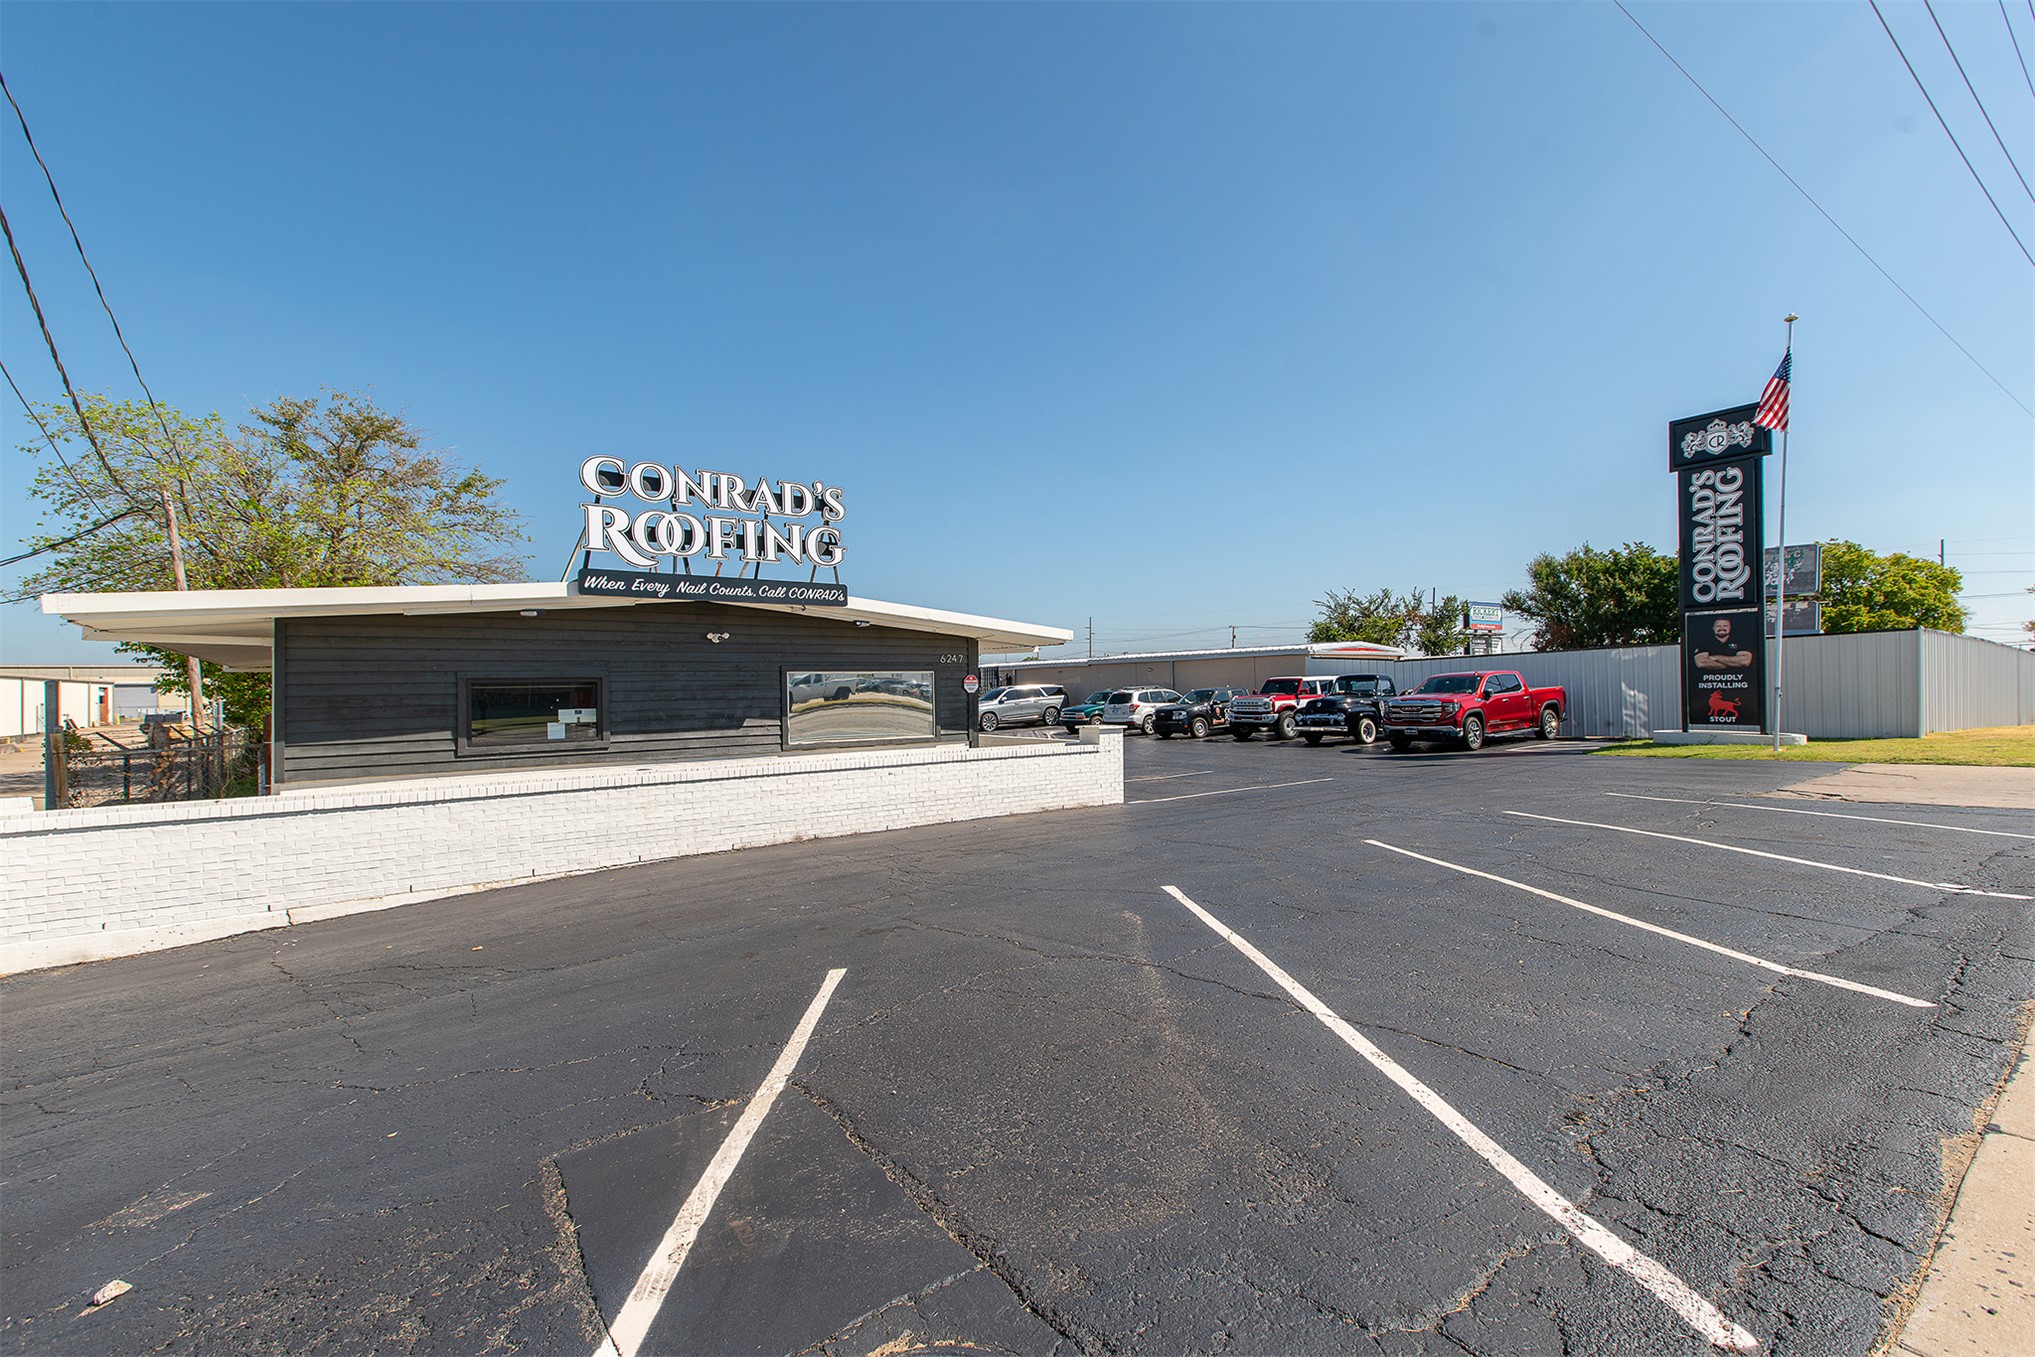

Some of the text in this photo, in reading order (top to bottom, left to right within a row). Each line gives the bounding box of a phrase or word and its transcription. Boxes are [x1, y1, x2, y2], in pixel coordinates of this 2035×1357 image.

[579, 454, 846, 523] CONRAD'S
[579, 502, 848, 568] ROOFING
[1688, 469, 1717, 603] CONRAD'S
[1715, 466, 1751, 602] ROOFING
[583, 575, 626, 590] When
[631, 578, 670, 598] Every
[676, 581, 708, 594] Nail
[758, 585, 786, 598] Call
[940, 654, 964, 664] 6247
[1702, 673, 1744, 681] PROUDLY
[1698, 681, 1749, 689] INSTALLING
